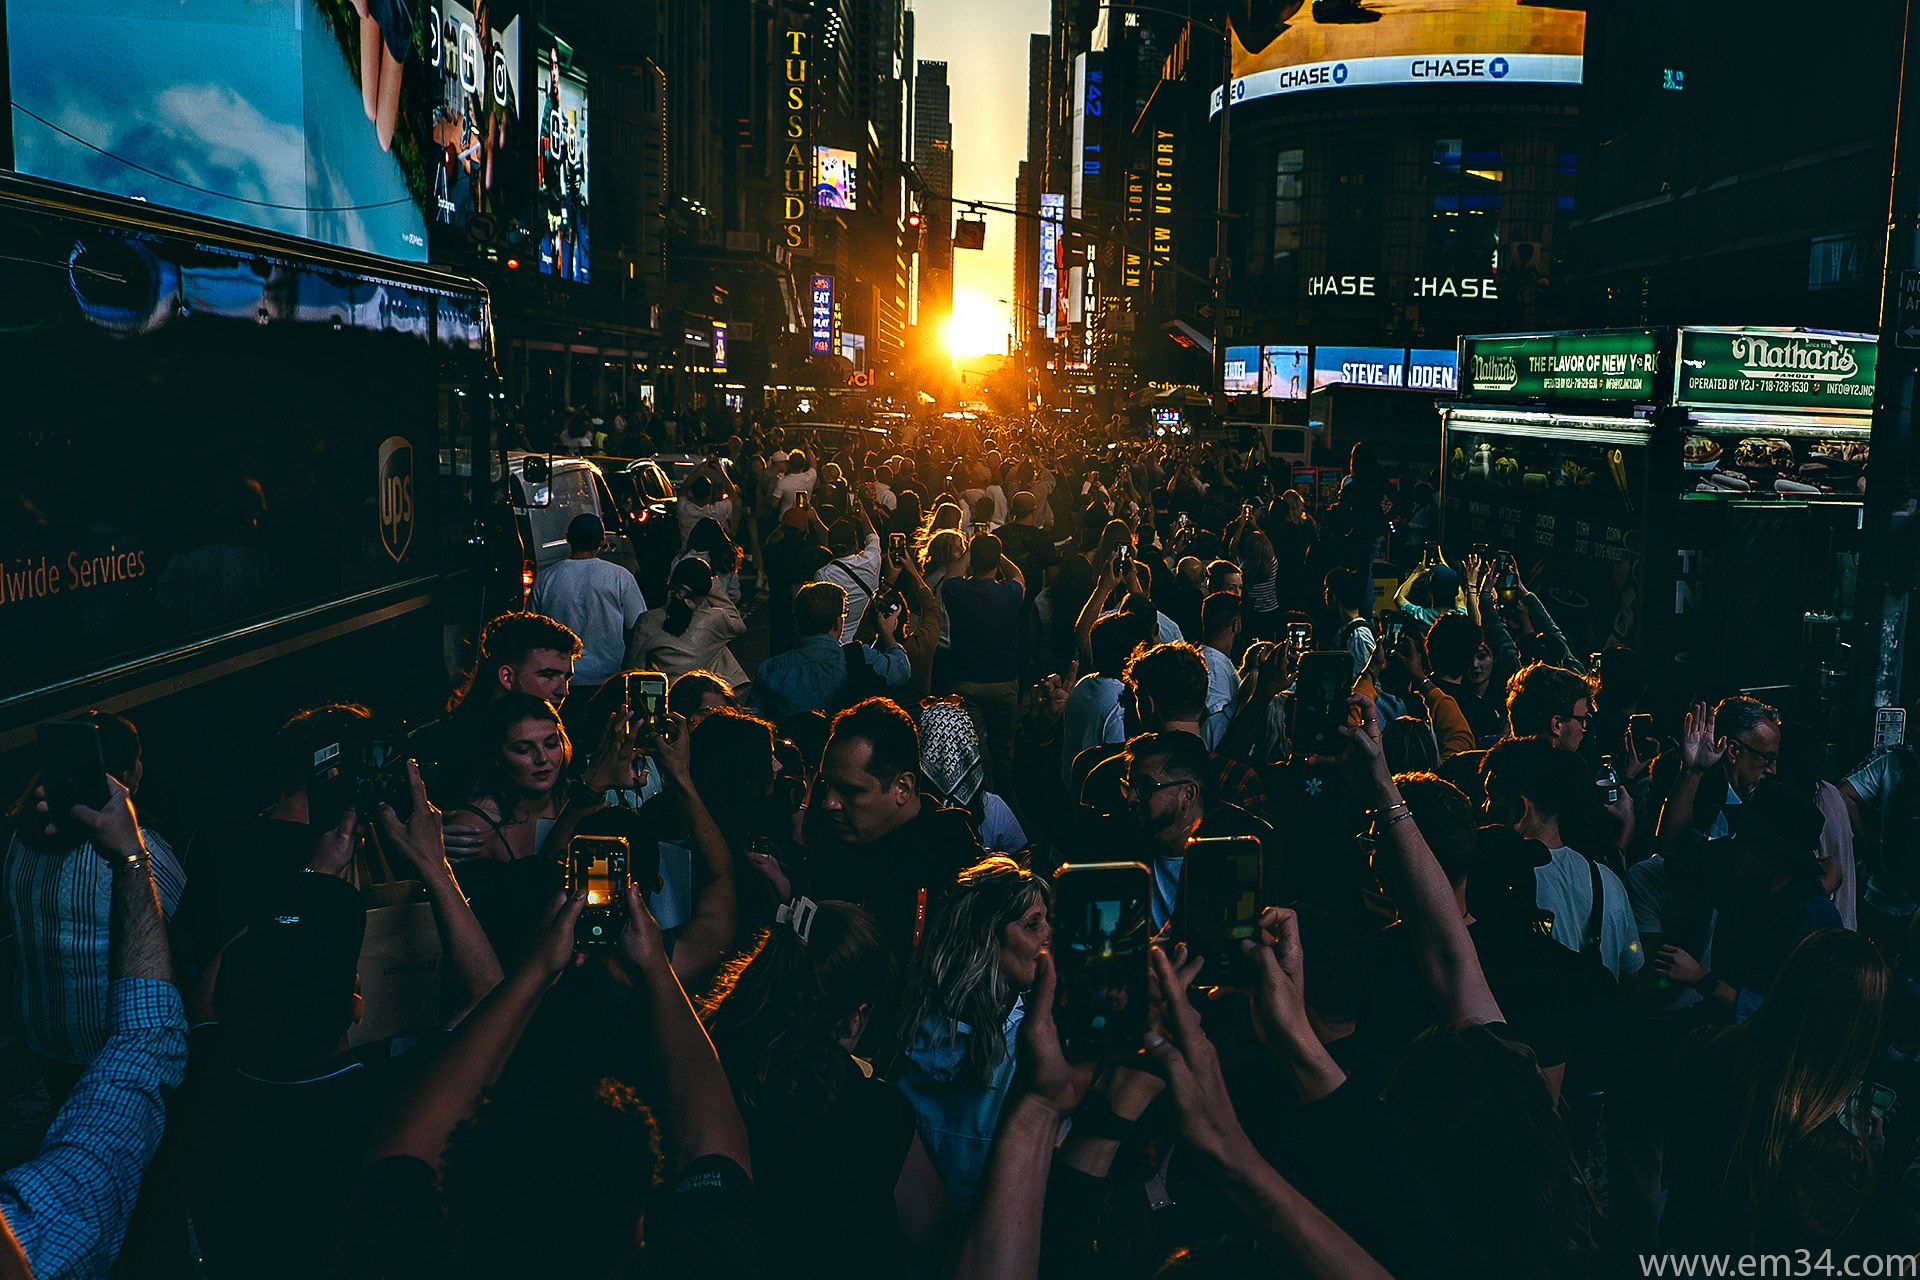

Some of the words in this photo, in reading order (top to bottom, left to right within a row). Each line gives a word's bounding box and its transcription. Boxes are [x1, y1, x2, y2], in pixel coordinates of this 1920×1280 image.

[1280, 67, 1330, 88] CHASE
[1411, 60, 1485, 77] CHASE
[1155, 130, 1174, 214] VICTORY
[1128, 173, 1143, 222] TORY
[1126, 254, 1141, 287] NEW
[813, 291, 830, 304] EAT
[1308, 275, 1376, 297] CHASE
[833, 302, 842, 356] EMPIRE
[1471, 353, 1518, 382] Nathan's
[1529, 356, 1546, 372] THE
[1549, 355, 1585, 372] FLAVOR
[1586, 355, 1600, 371] OF
[1601, 354, 1628, 372] NEW
[1732, 336, 1857, 373] Nathan's
[1341, 362, 1384, 386] STEVE
[1689, 377, 1727, 391] OPERATED
[1728, 378, 1739, 391] BY
[1740, 379, 1755, 392] Y2J
[1760, 379, 1809, 393] 718-728-1530
[381, 475, 412, 545] ups
[67, 545, 146, 591] Services
